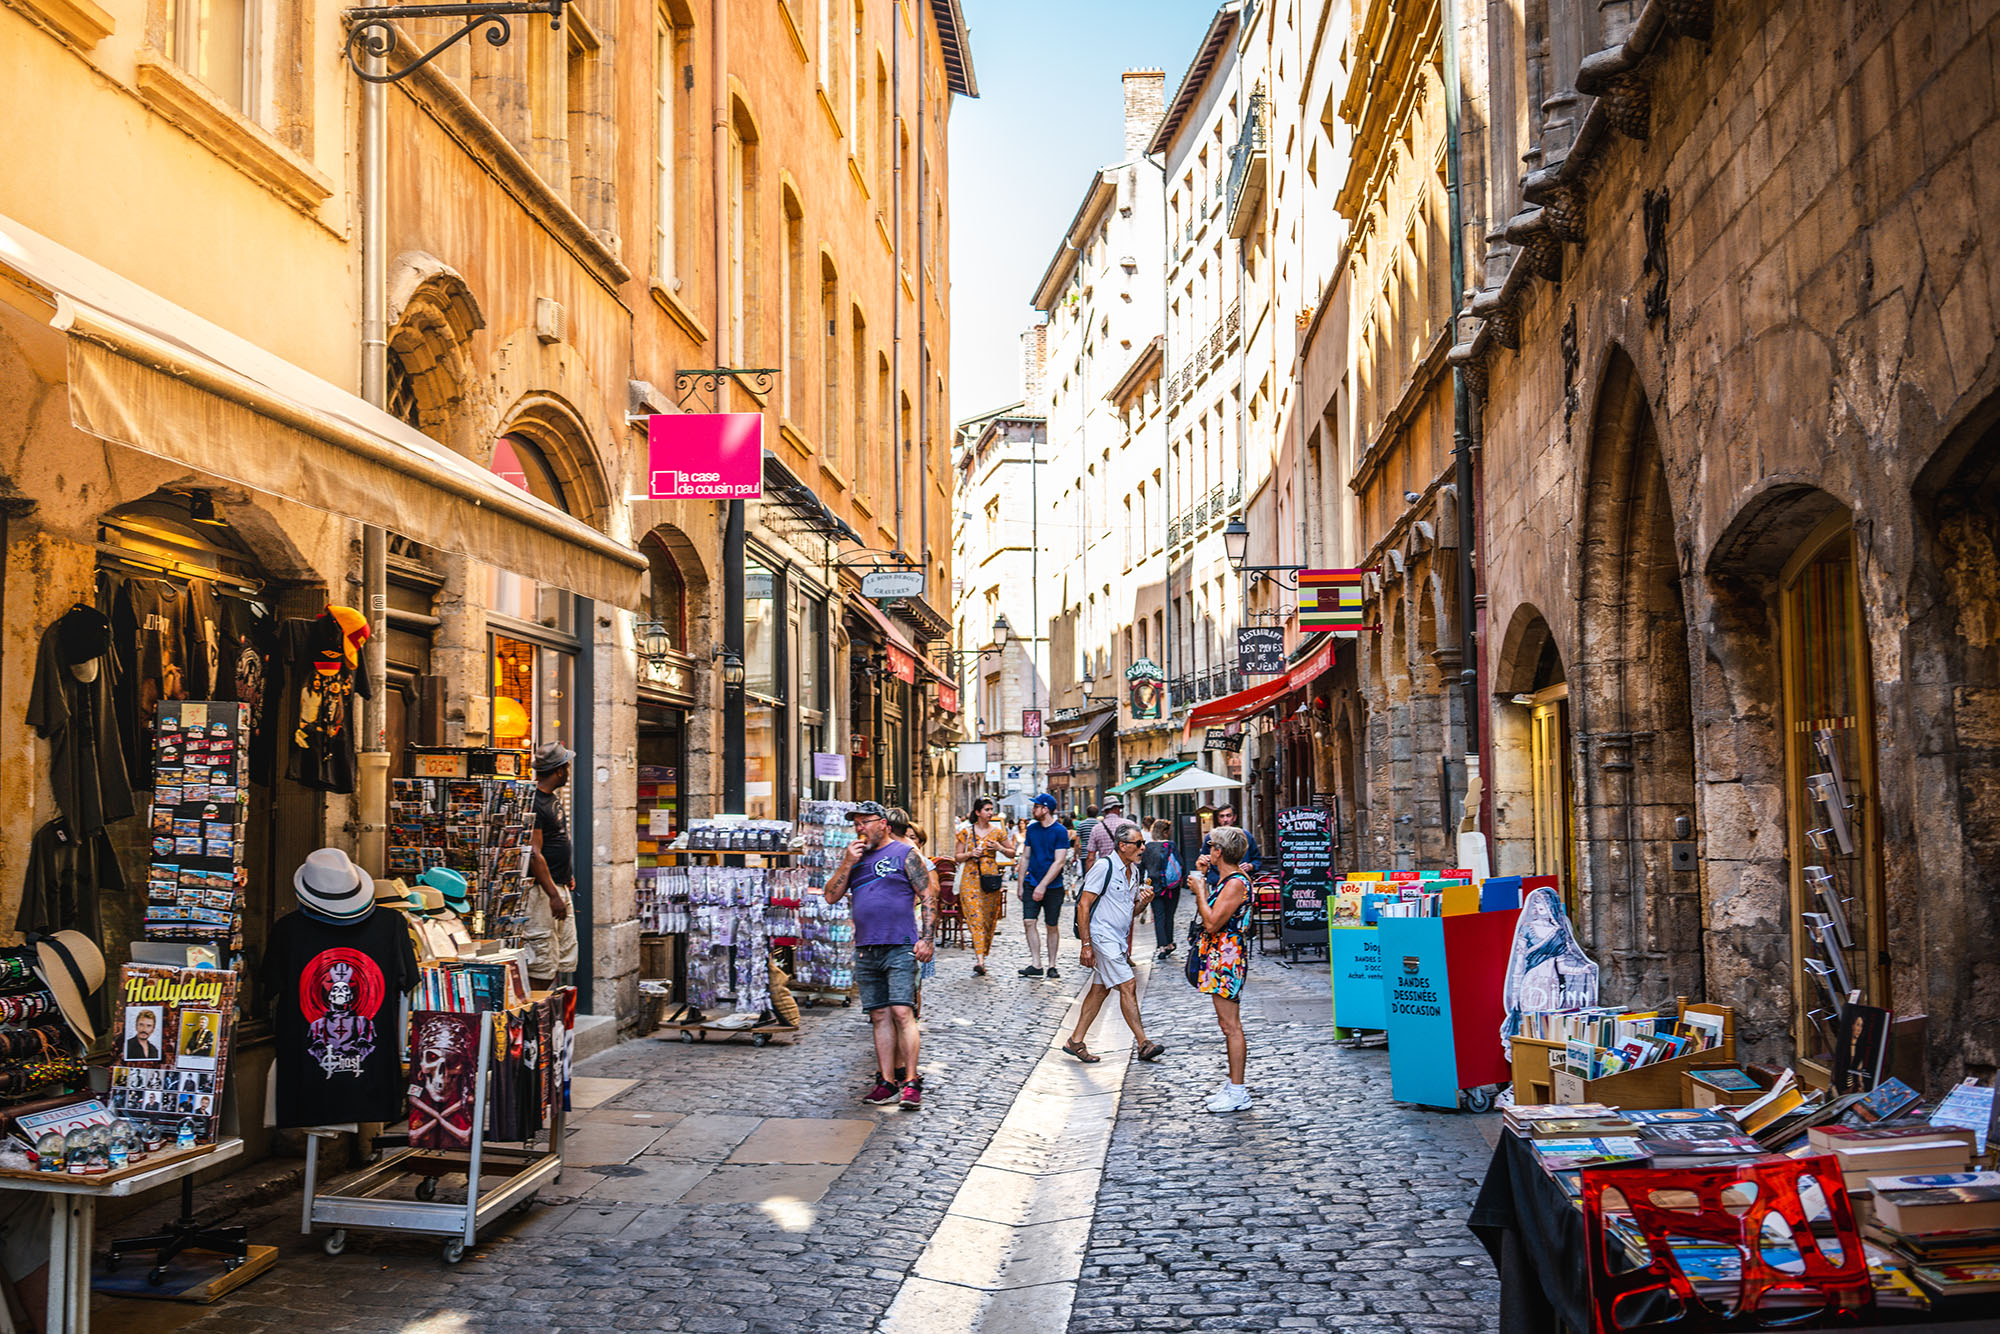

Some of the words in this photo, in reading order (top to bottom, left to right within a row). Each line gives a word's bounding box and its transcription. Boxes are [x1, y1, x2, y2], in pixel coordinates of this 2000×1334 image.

[679, 470, 690, 482] la
[690, 472, 720, 482] case
[678, 483, 694, 495] de
[695, 482, 733, 495] cousin
[735, 482, 760, 496] paul
[1239, 628, 1283, 643] RESTAURANT
[1240, 644, 1256, 654] LES
[1257, 661, 1279, 671] JEAN
[1294, 820, 1317, 831] LYON
[1292, 889, 1317, 899] SERVICE
[1398, 976, 1430, 989] BANDES
[125, 977, 223, 1009] Hallyday
[1393, 989, 1437, 1003] DESSINÉES
[1391, 1001, 1441, 1017] D'OCCASION
[319, 1044, 365, 1080] Ghost
[43, 1107, 80, 1121] FRANCE
